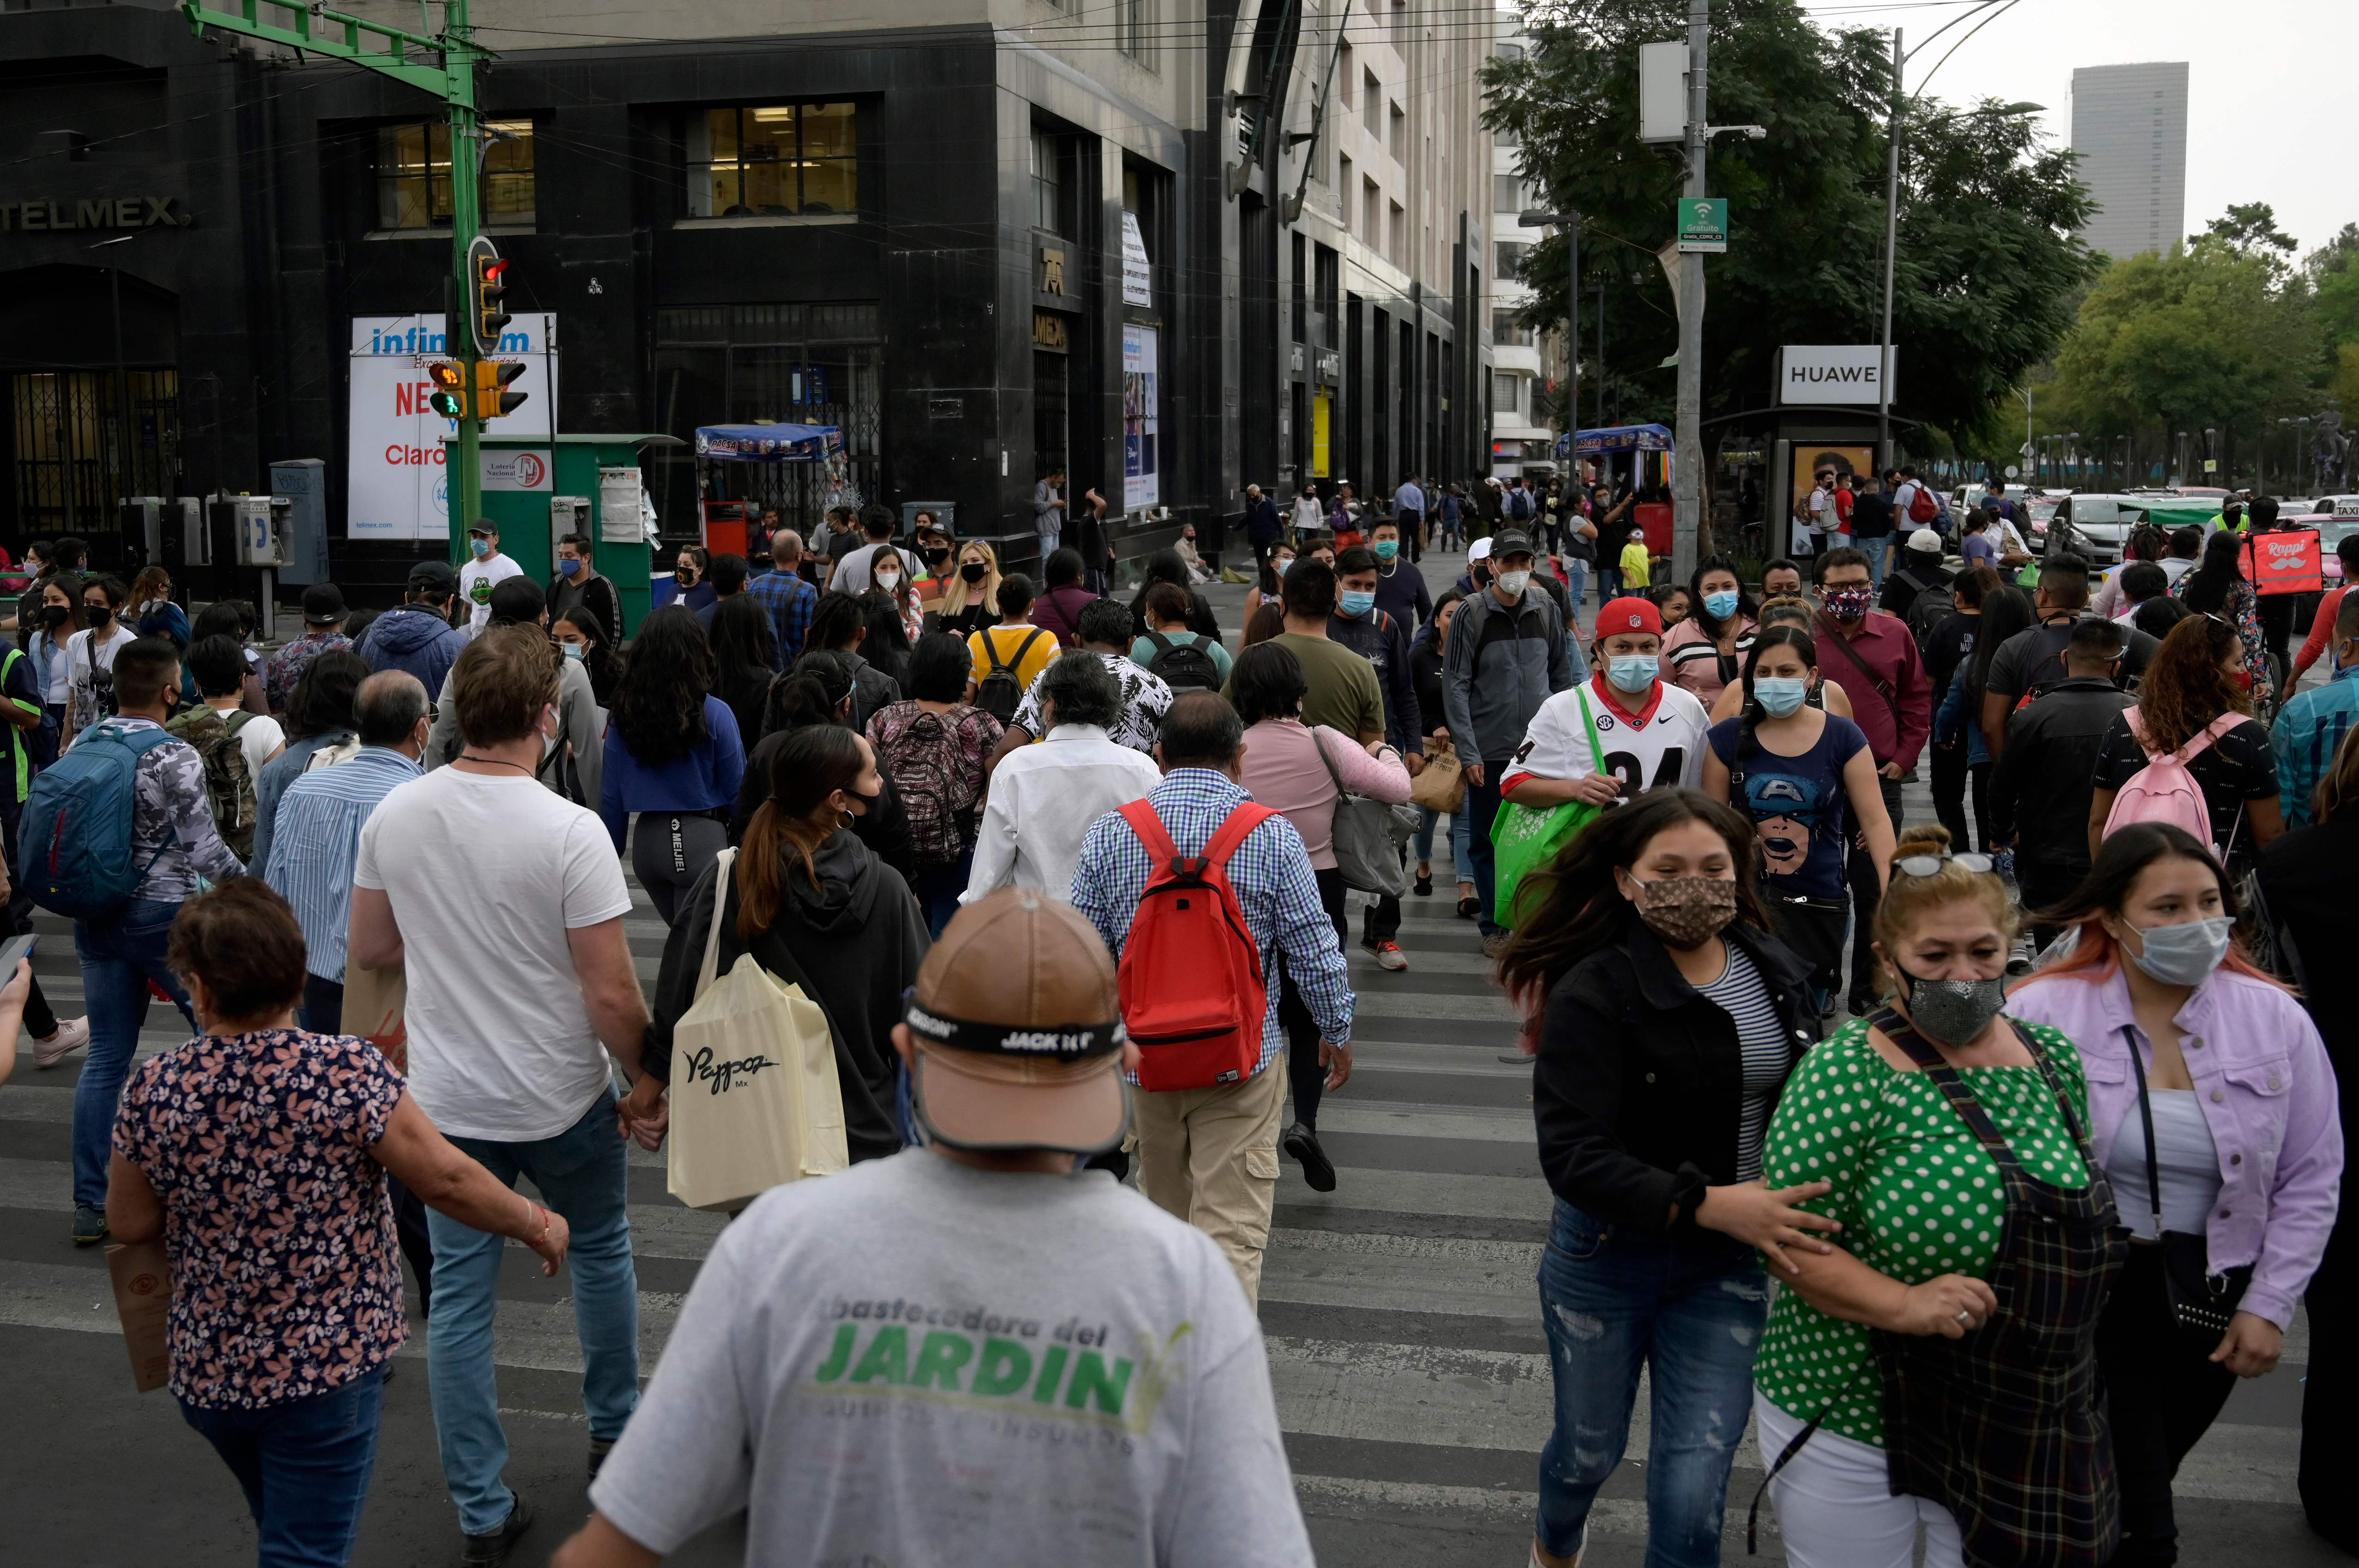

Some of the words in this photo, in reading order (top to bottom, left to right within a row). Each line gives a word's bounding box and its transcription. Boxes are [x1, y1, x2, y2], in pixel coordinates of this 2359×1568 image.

[0, 197, 177, 230] TELMEX
[1791, 367, 1877, 382] HUAWE
[710, 439, 738, 452] PACSA
[1575, 439, 1601, 449] PACSA
[2337, 507, 2359, 515] TAXI
[2268, 540, 2305, 557] Rappi
[1598, 716, 1612, 729] SEC
[1435, 754, 1456, 766] Cuidado
[1438, 763, 1453, 773] Perro
[1001, 1031, 1060, 1051] JACK
[1053, 1316, 1107, 1346] del
[815, 1323, 1134, 1416] JARDIN
